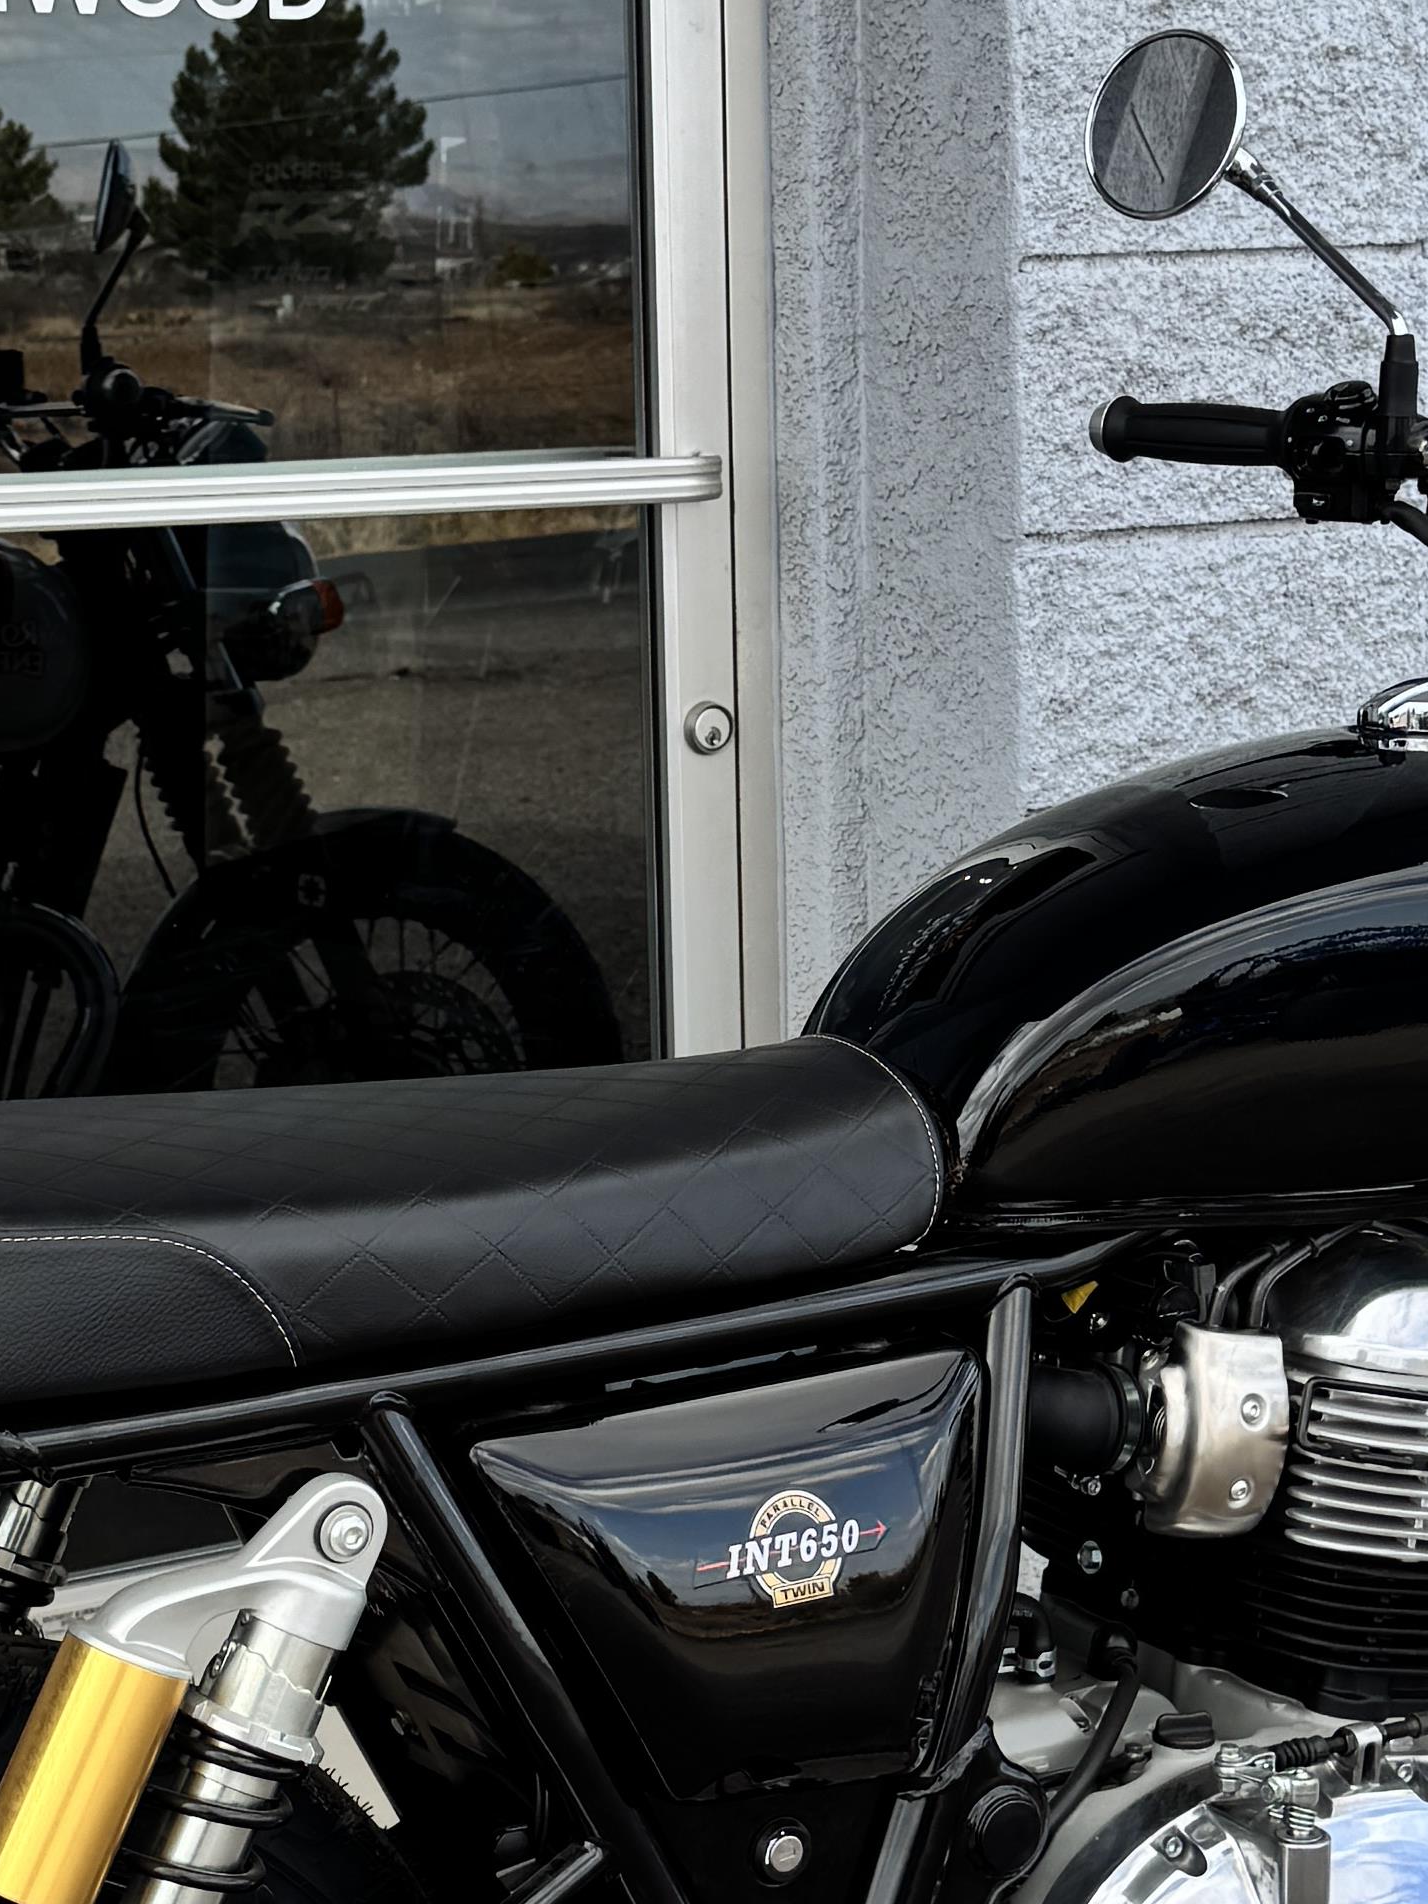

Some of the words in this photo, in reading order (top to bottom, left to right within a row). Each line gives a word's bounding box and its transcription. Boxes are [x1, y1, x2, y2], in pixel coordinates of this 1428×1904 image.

[760, 1497, 821, 1528] PARALLEL
[726, 1519, 860, 1579] INT650
[779, 1581, 825, 1601] TWIN
